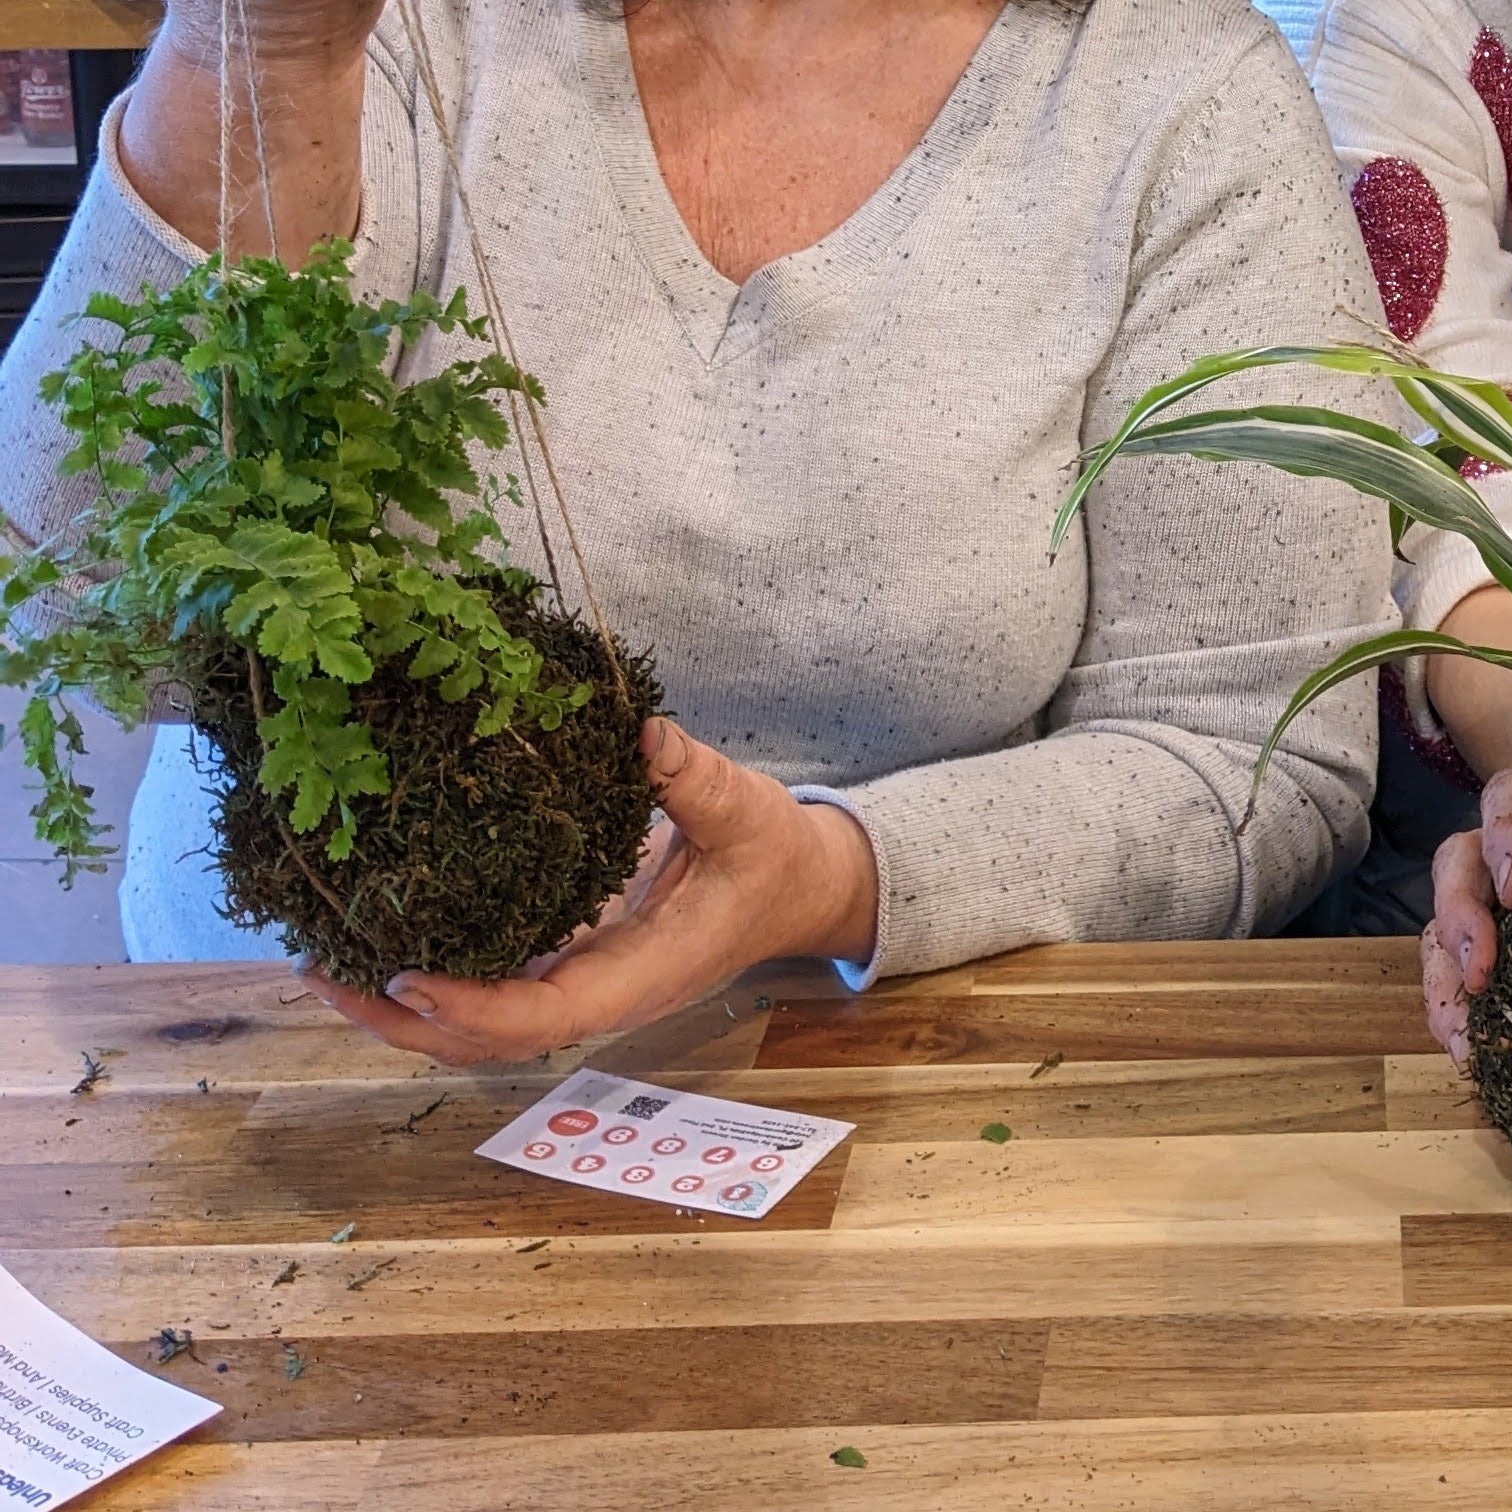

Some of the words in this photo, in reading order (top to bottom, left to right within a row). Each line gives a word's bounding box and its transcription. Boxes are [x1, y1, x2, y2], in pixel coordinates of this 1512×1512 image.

[607, 1128, 632, 1142] 9
[527, 1144, 552, 1158] 5
[656, 1139, 682, 1153] 8
[706, 1148, 731, 1162] 7
[576, 1157, 600, 1170] 4
[755, 1156, 779, 1169] 6
[625, 1167, 651, 1182] 3
[675, 1178, 701, 1190] 2
[13, 1360, 46, 1384] And
[48, 1384, 110, 1423] Supplies
[35, 1410, 85, 1441] Events
[104, 1416, 145, 1440] Craft
[80, 1435, 133, 1464] Private
[63, 1458, 104, 1481] Craft
